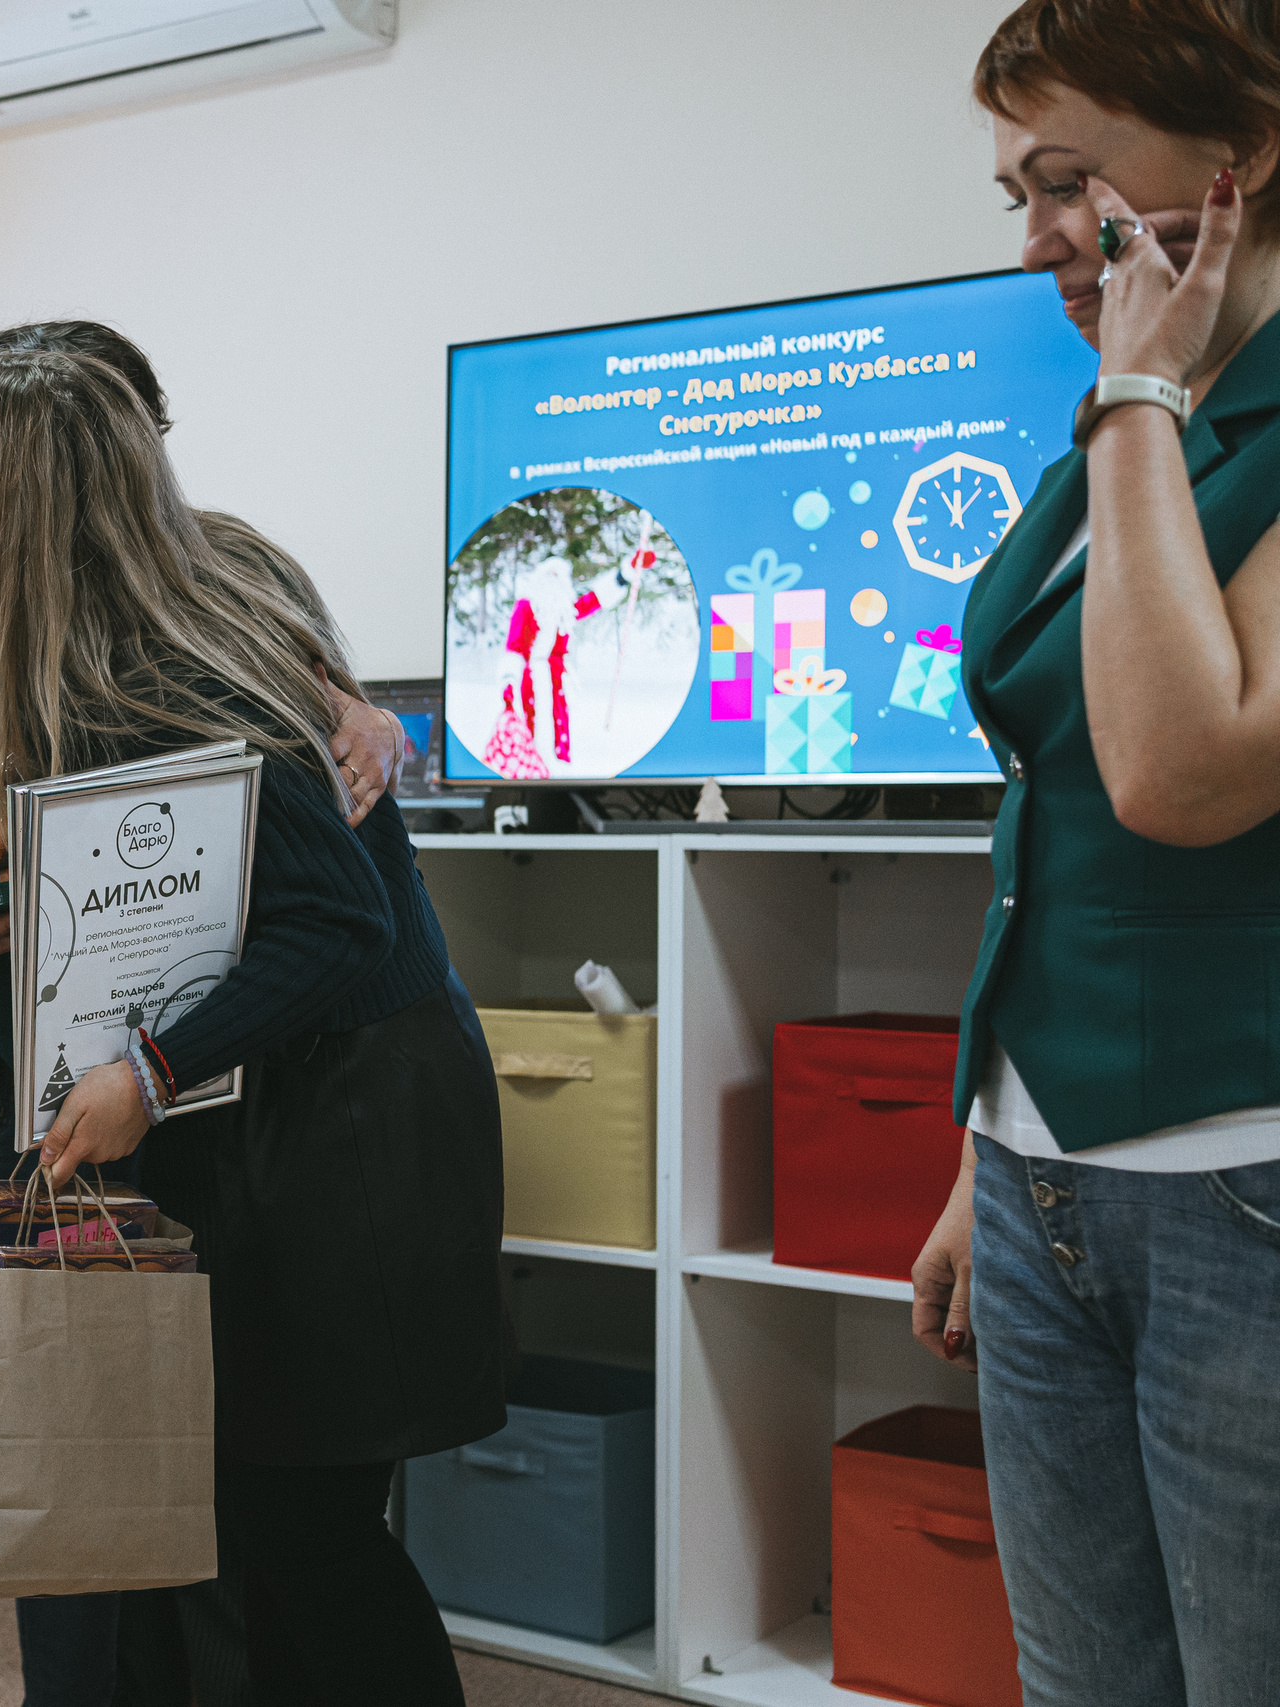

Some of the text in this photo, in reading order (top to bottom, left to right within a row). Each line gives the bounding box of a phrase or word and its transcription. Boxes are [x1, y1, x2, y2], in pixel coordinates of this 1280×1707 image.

[606, 326, 884, 376] Региональный конкурс
[535, 387, 661, 415] «Волонтер
[683, 378, 734, 405] Дед
[740, 368, 822, 395] Мороз
[829, 354, 950, 387] Кузбасса
[957, 350, 976, 369] и
[659, 404, 822, 436] Снегурочка»
[526, 459, 581, 480] рамках
[584, 445, 702, 472] Всероссийской
[704, 443, 757, 461] акции
[760, 432, 828, 454] «Новый
[831, 433, 862, 449] год
[879, 420, 953, 444] каждый
[957, 419, 1006, 439] дом»
[123, 822, 161, 837] Благо
[128, 835, 167, 852] Дарю
[81, 870, 200, 917] ДИПЛОМ
[119, 904, 164, 917] 3 степени
[85, 914, 195, 943] регионального конкурса
[88, 944, 109, 955] Дед
[184, 921, 226, 937] Кузбасса
[72, 990, 204, 1024] Анатолий Валентинович
[110, 982, 165, 1000] Болдырев
